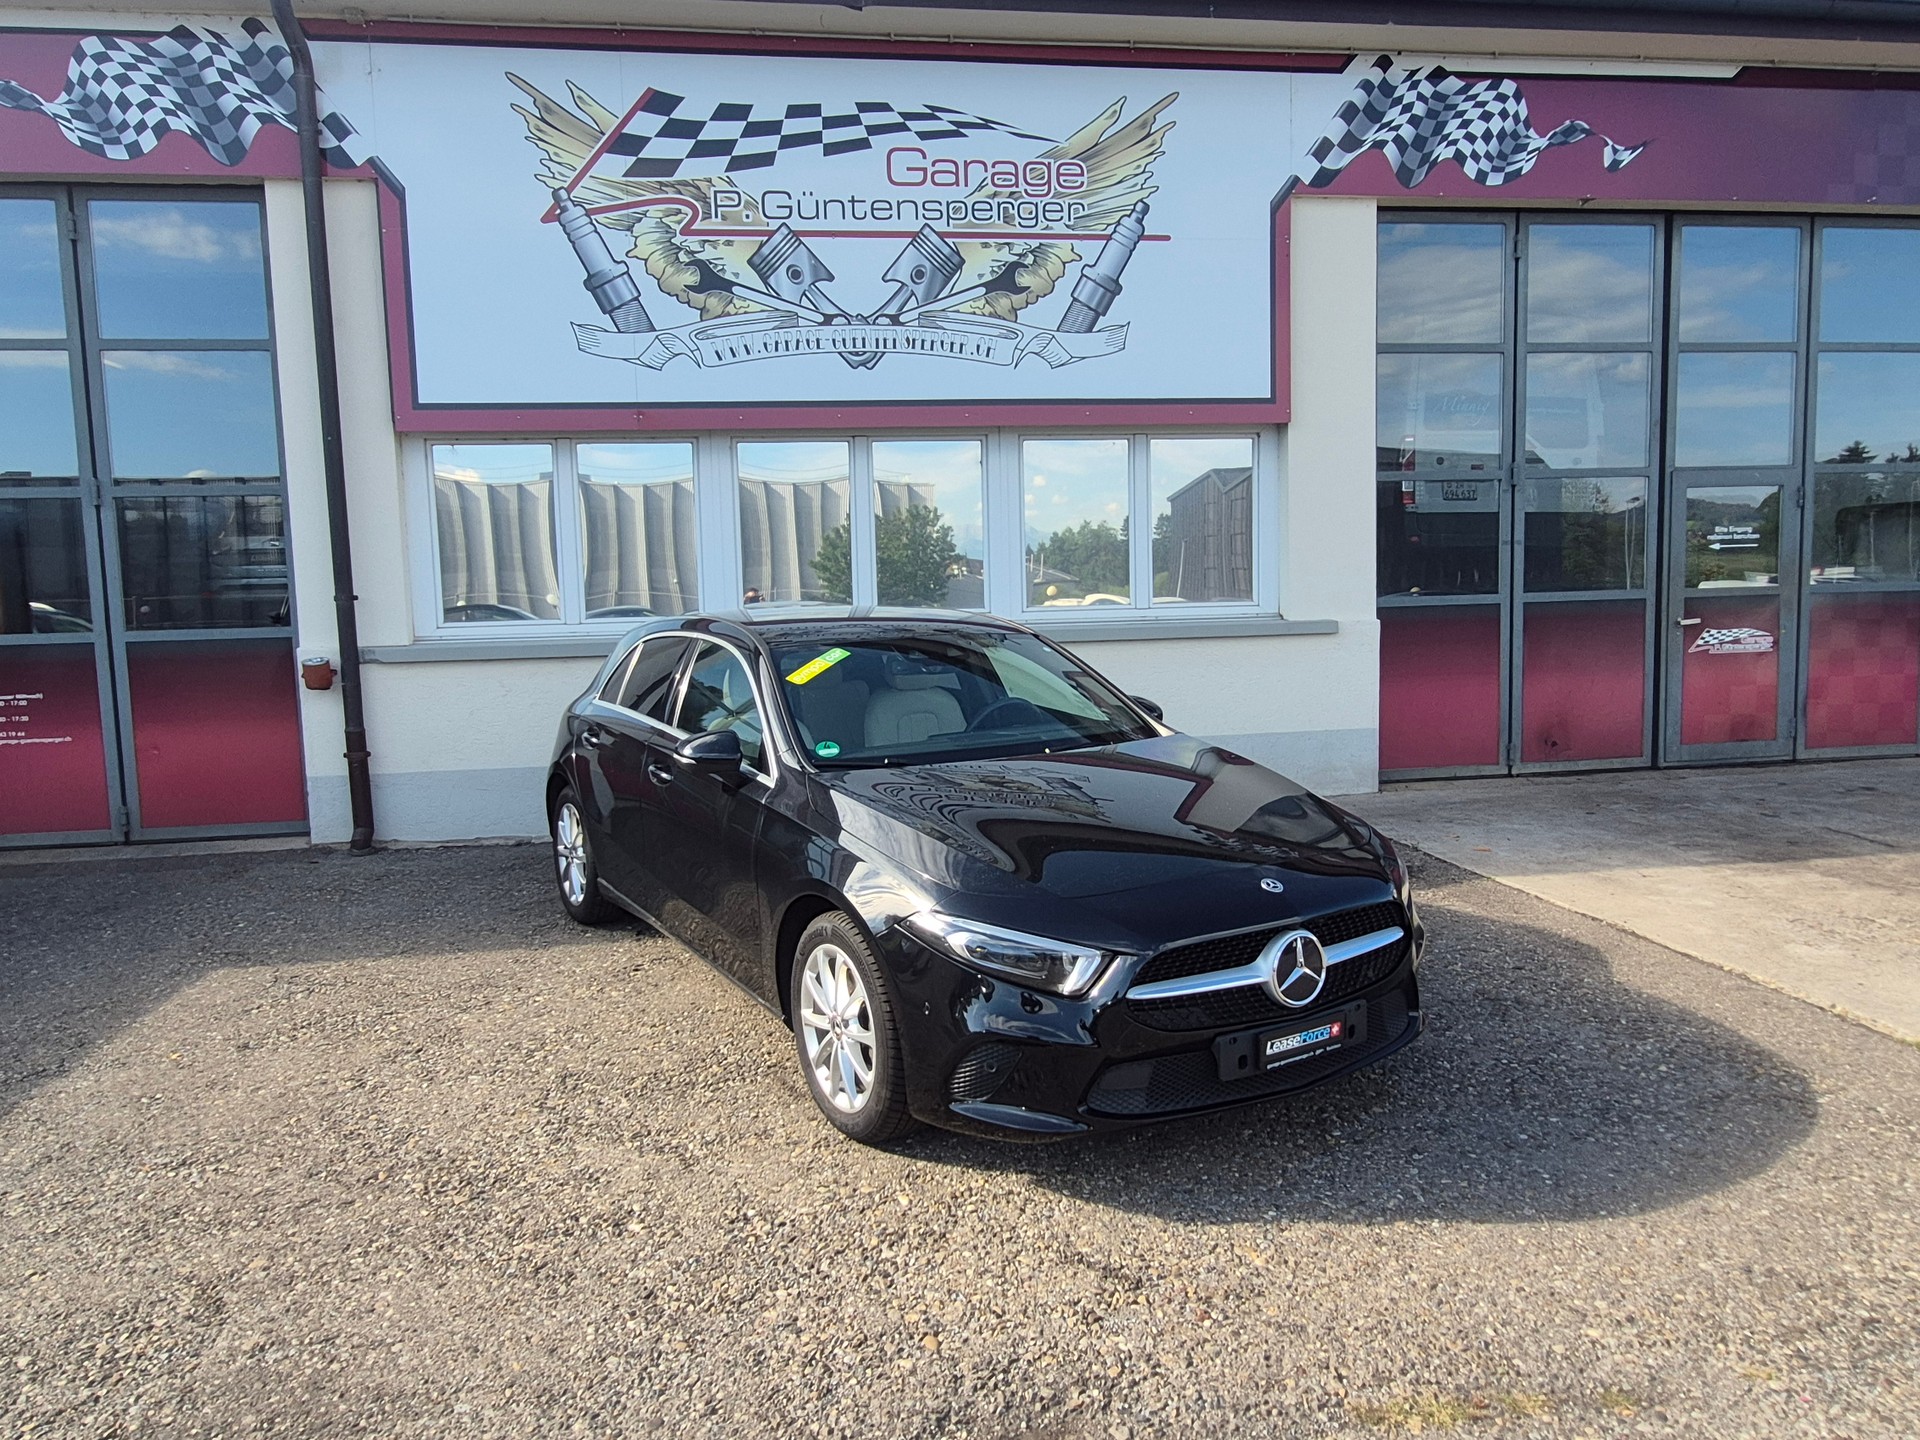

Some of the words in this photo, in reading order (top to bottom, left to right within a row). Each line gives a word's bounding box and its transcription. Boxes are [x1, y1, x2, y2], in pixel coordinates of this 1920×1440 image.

[886, 146, 1086, 198] Garage
[710, 328, 998, 362] WWW.GARAGE-GUENTENSPERGER.CH
[1265, 1026, 1331, 1056] LeaseForce
